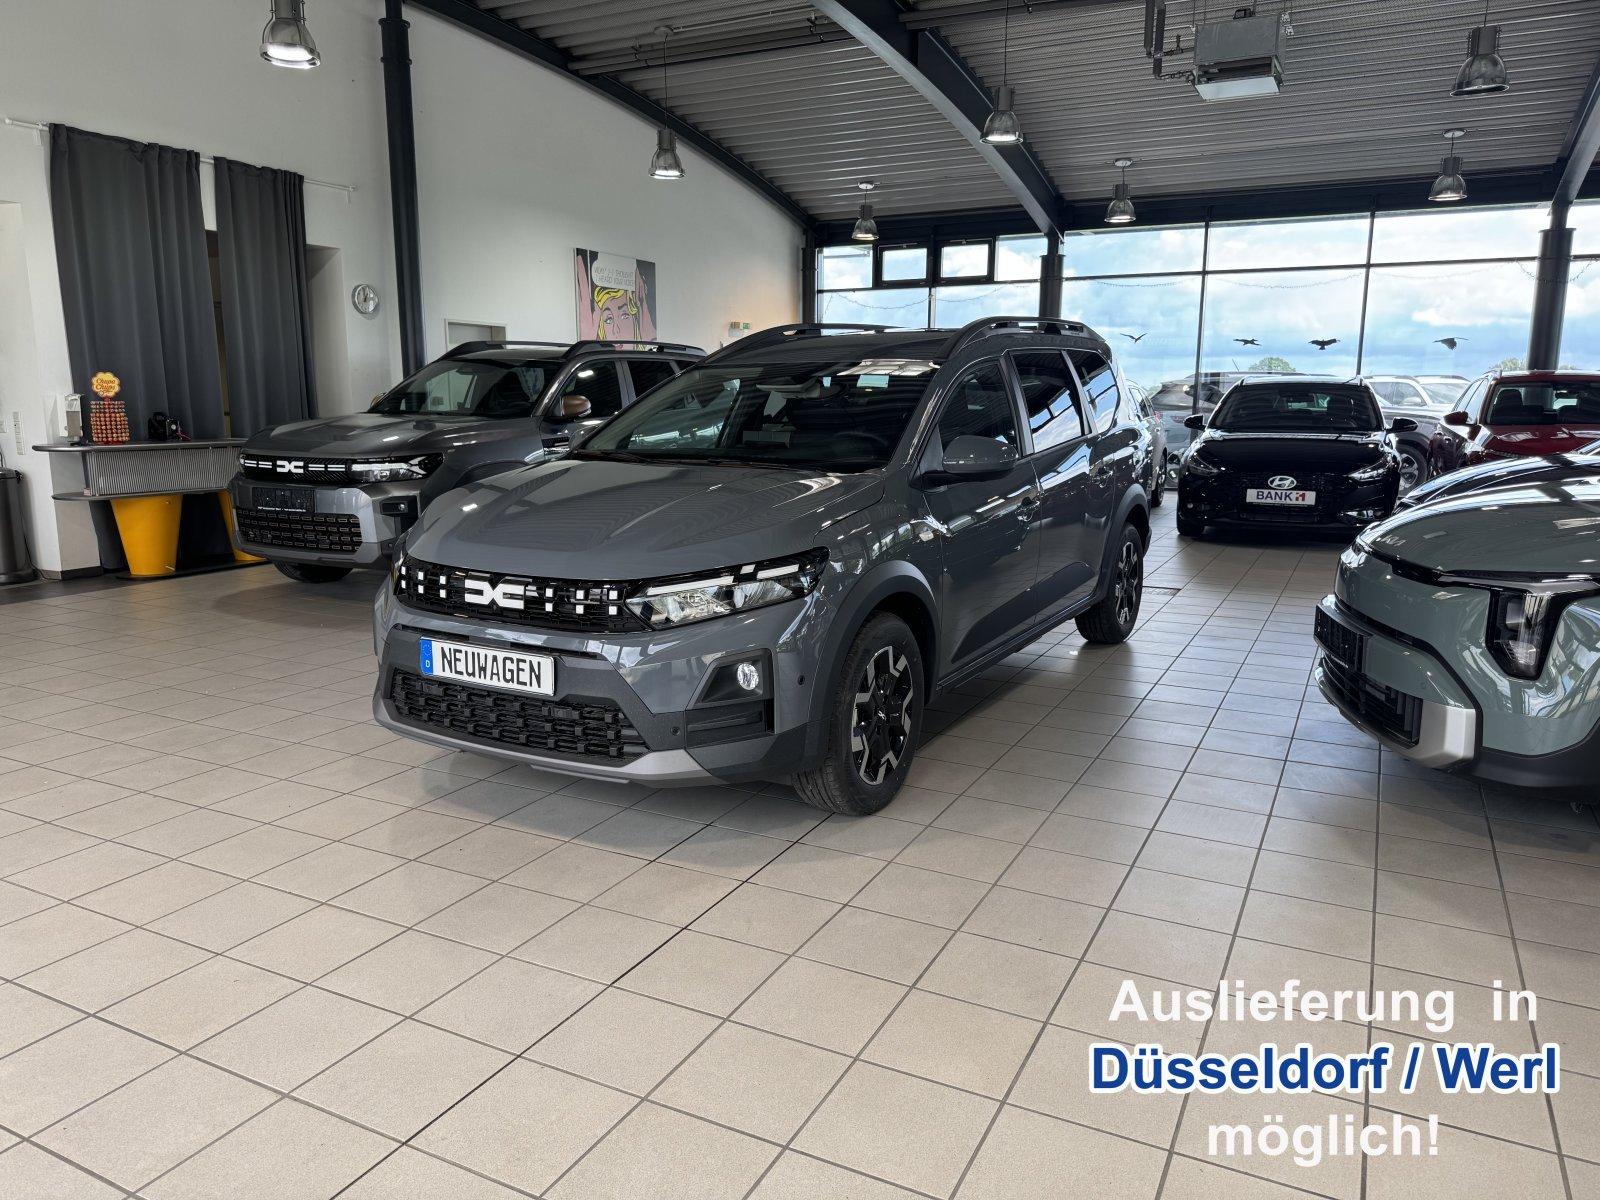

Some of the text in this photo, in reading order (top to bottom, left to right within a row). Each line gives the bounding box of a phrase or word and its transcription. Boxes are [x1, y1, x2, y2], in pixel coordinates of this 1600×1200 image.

[1256, 490, 1293, 501] BANK
[425, 646, 541, 689] D NEUWAGEN
